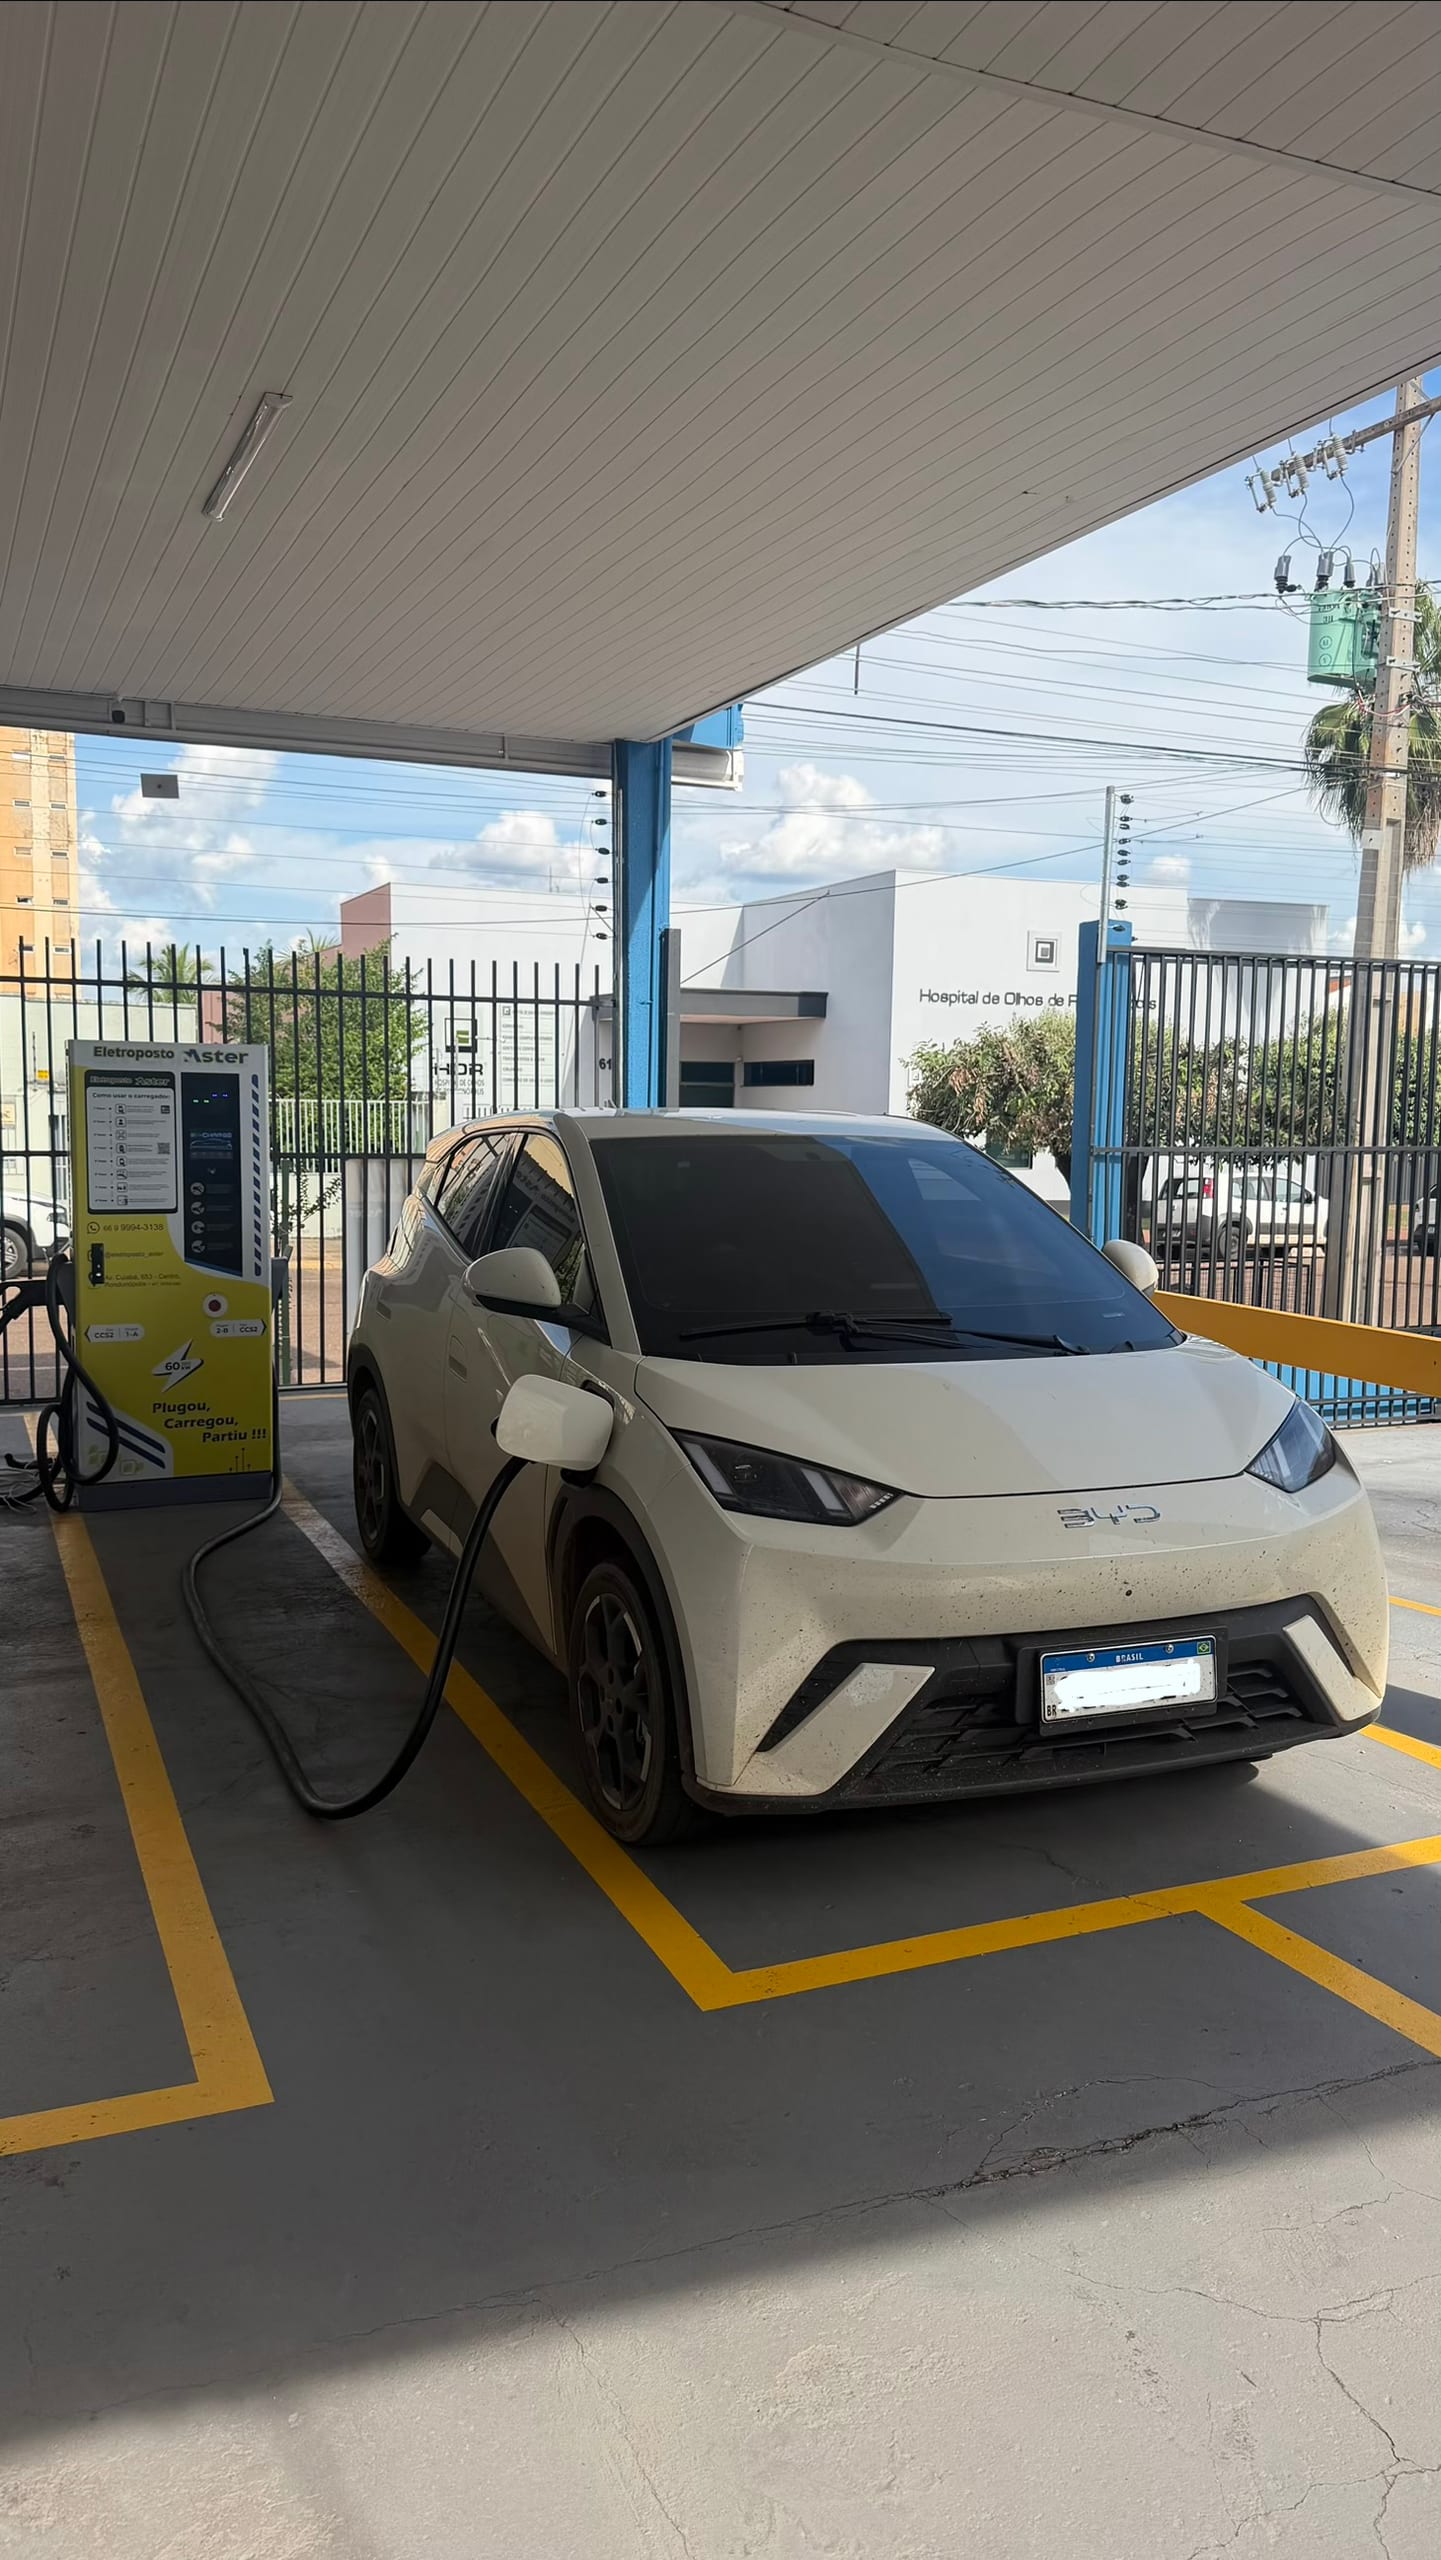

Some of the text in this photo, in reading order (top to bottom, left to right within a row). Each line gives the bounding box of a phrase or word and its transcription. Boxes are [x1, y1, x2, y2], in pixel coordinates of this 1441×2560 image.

[919, 988, 979, 1007] Hospital
[982, 992, 1000, 1005] de
[1004, 991, 1043, 1007] Olhos
[1048, 993, 1065, 1007] de
[93, 1046, 249, 1064] Eletroposto Aster
[121, 1223, 164, 1232] 9994-3138
[94, 1331, 114, 1339] CCS2
[239, 1325, 259, 1334] CCS2
[165, 1361, 181, 1371] 60
[152, 1402, 211, 1415] Plugou,
[164, 1416, 239, 1430] Carregou,
[202, 1428, 267, 1443] Partiu !!!
[1057, 1504, 1161, 1529] BYD
[1115, 1652, 1145, 1663] BRASIL
[1046, 1704, 1057, 1717] BR
